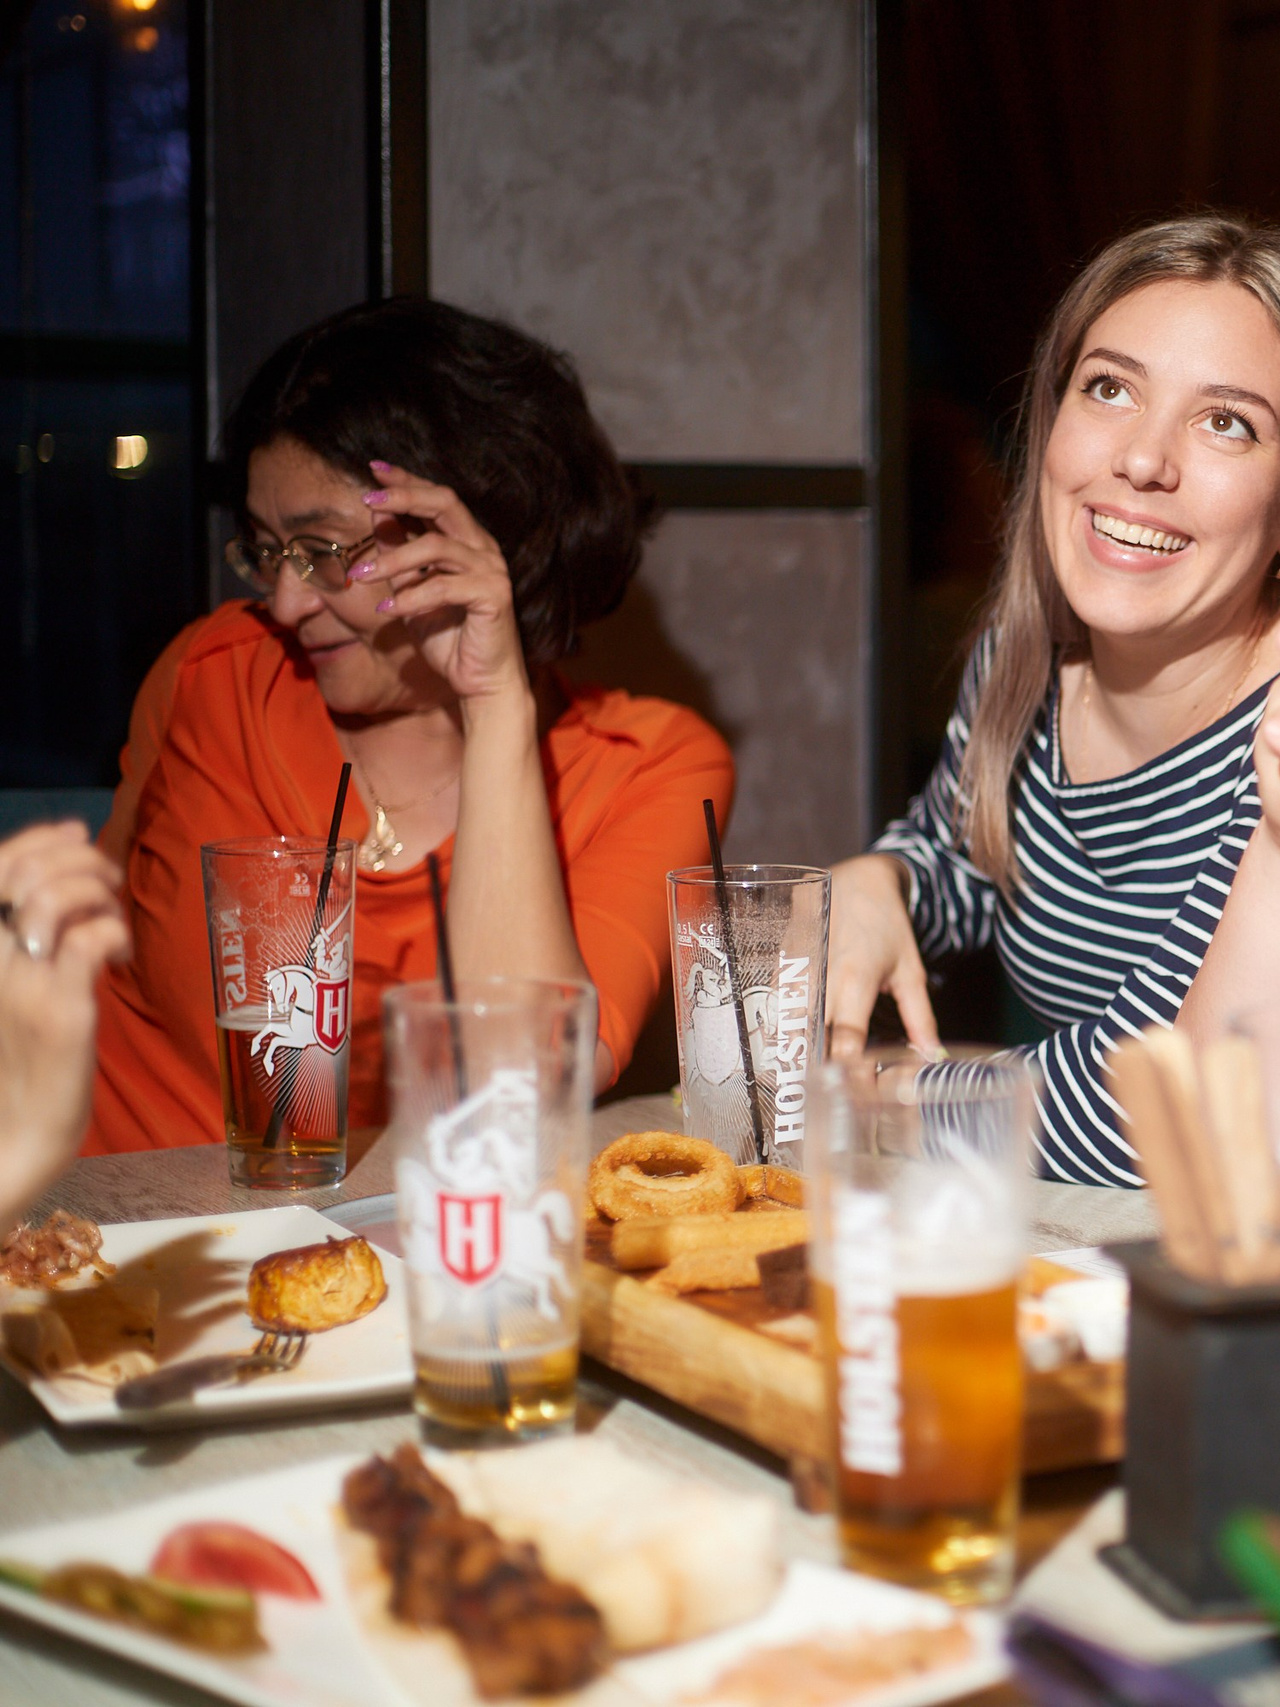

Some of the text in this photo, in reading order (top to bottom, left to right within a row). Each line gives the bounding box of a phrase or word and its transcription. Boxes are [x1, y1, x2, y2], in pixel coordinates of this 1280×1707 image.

[699, 923, 714, 935] CE
[322, 986, 346, 1038] H
[774, 954, 811, 1145] HOLSTEN
[443, 1200, 499, 1273] H
